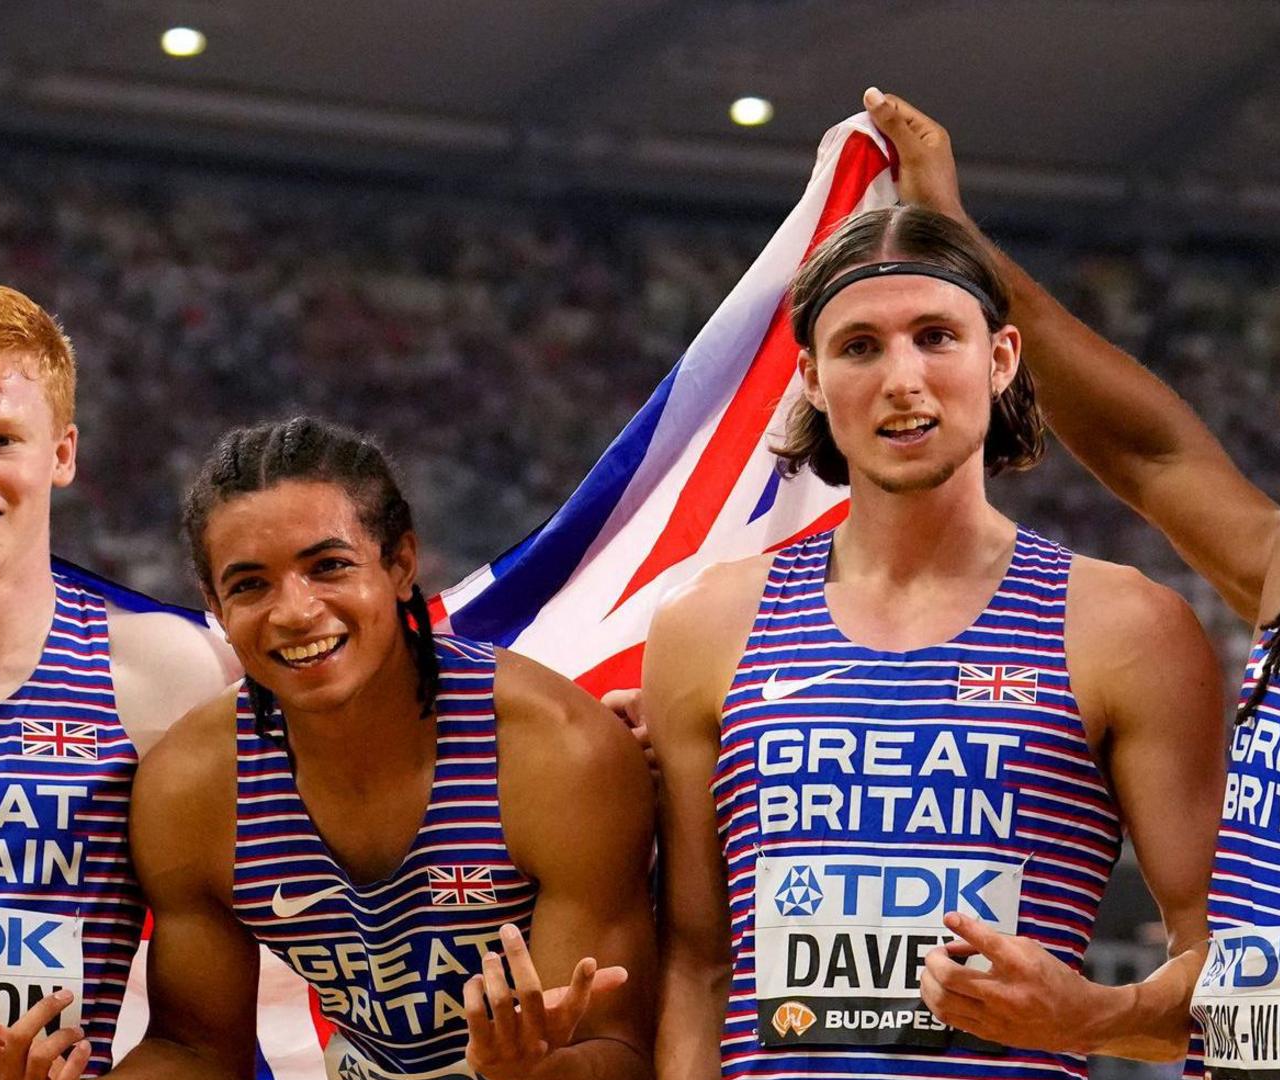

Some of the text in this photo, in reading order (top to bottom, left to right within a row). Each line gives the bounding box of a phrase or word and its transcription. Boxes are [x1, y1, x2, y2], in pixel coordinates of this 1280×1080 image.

[757, 728, 1020, 780] GREAT
[758, 784, 1015, 840] BRITAIN
[823, 864, 1003, 923] TDK
[320, 986, 469, 1036] BRITA
[825, 1010, 956, 1032] BUDAPES
